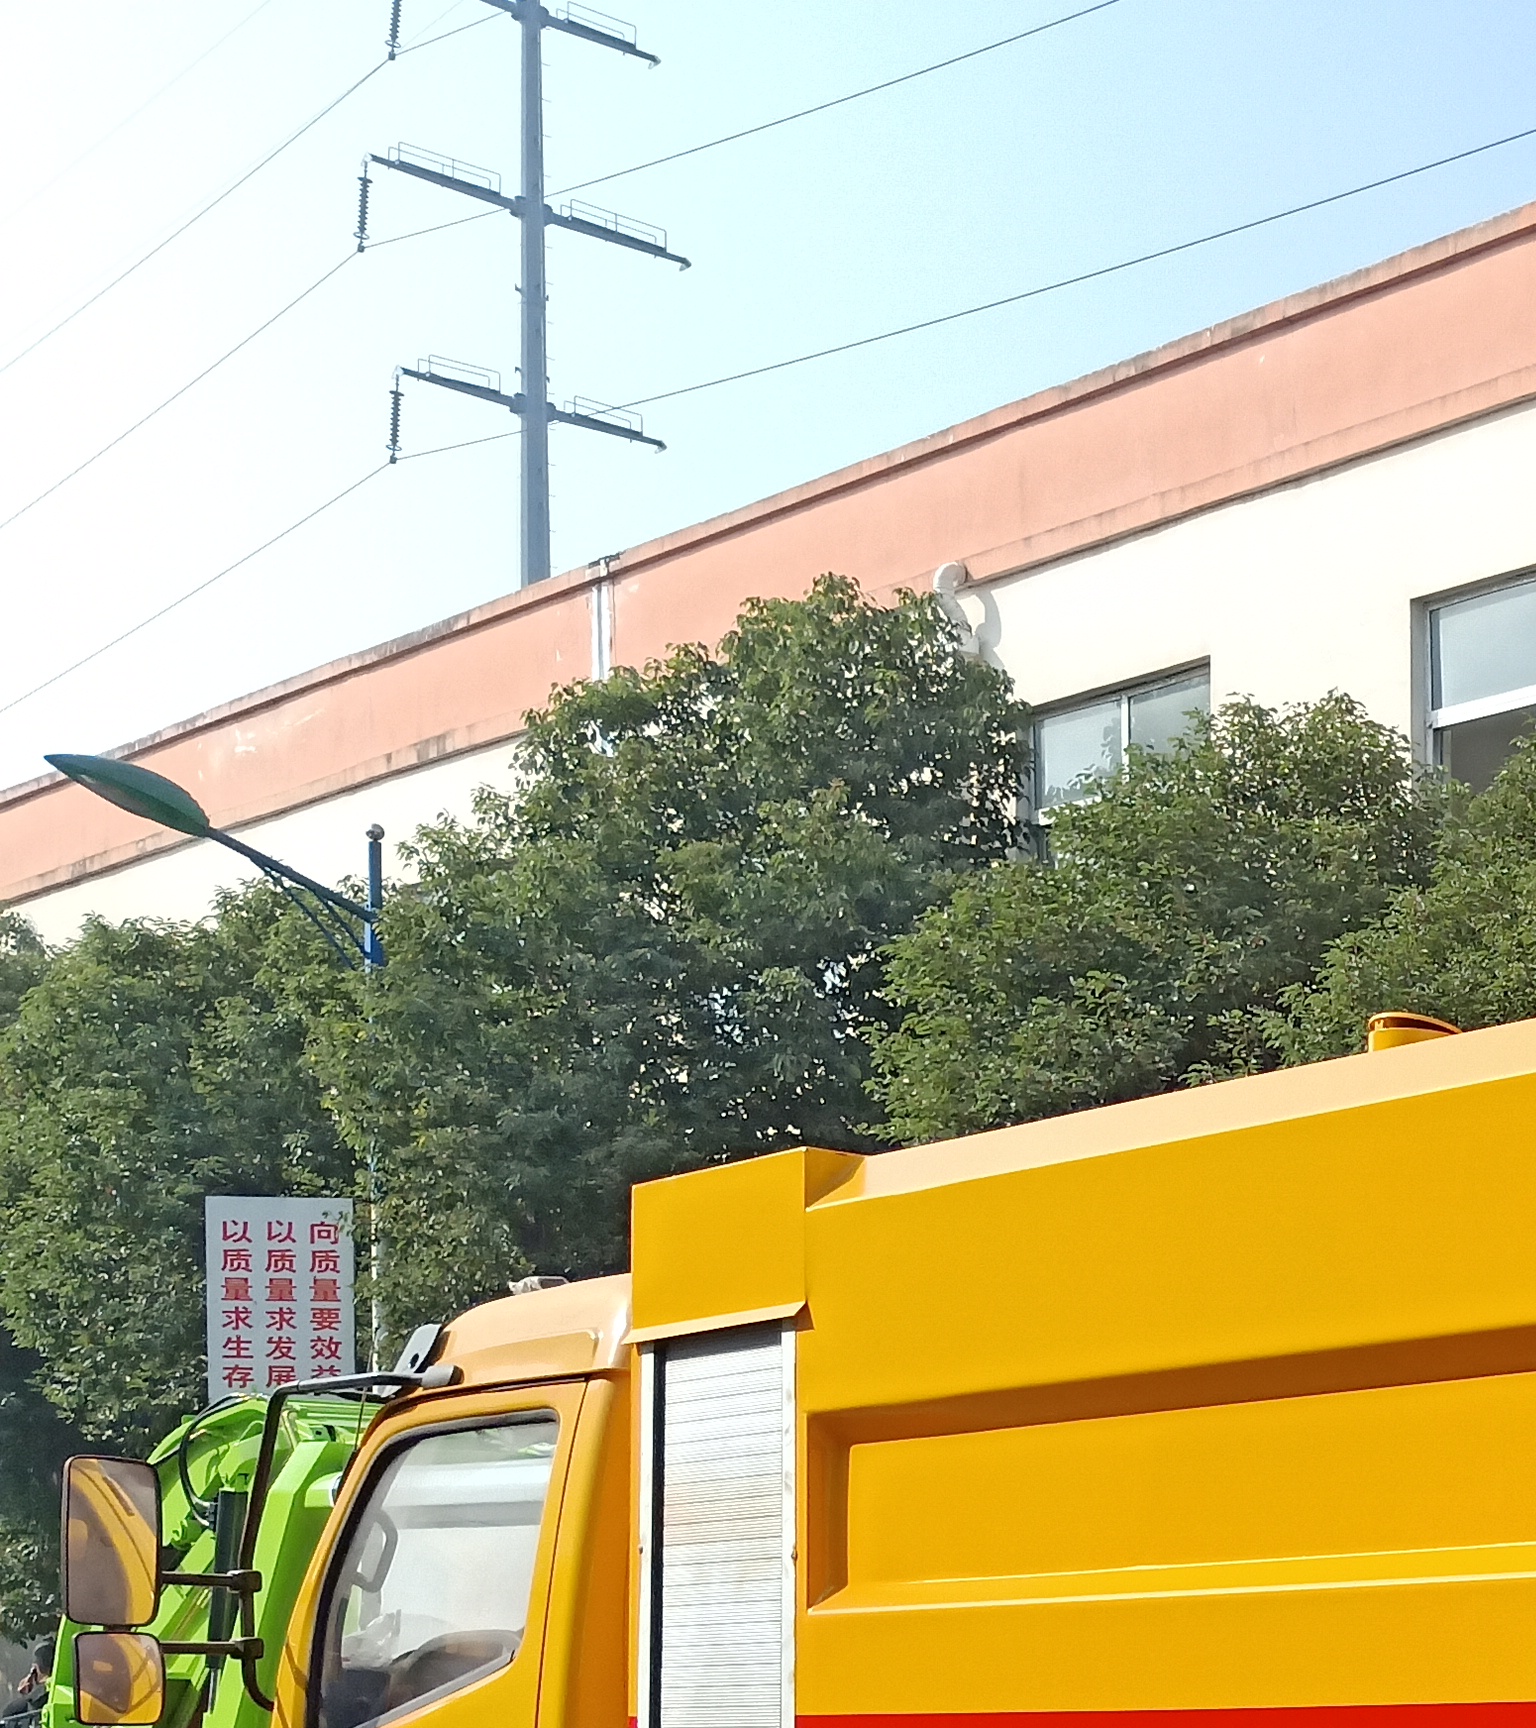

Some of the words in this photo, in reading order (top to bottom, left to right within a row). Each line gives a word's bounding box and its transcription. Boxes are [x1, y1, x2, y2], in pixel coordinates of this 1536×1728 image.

[221, 1220, 253, 1388] 以质量求生存
[265, 1219, 297, 1388] 以质量求发展
